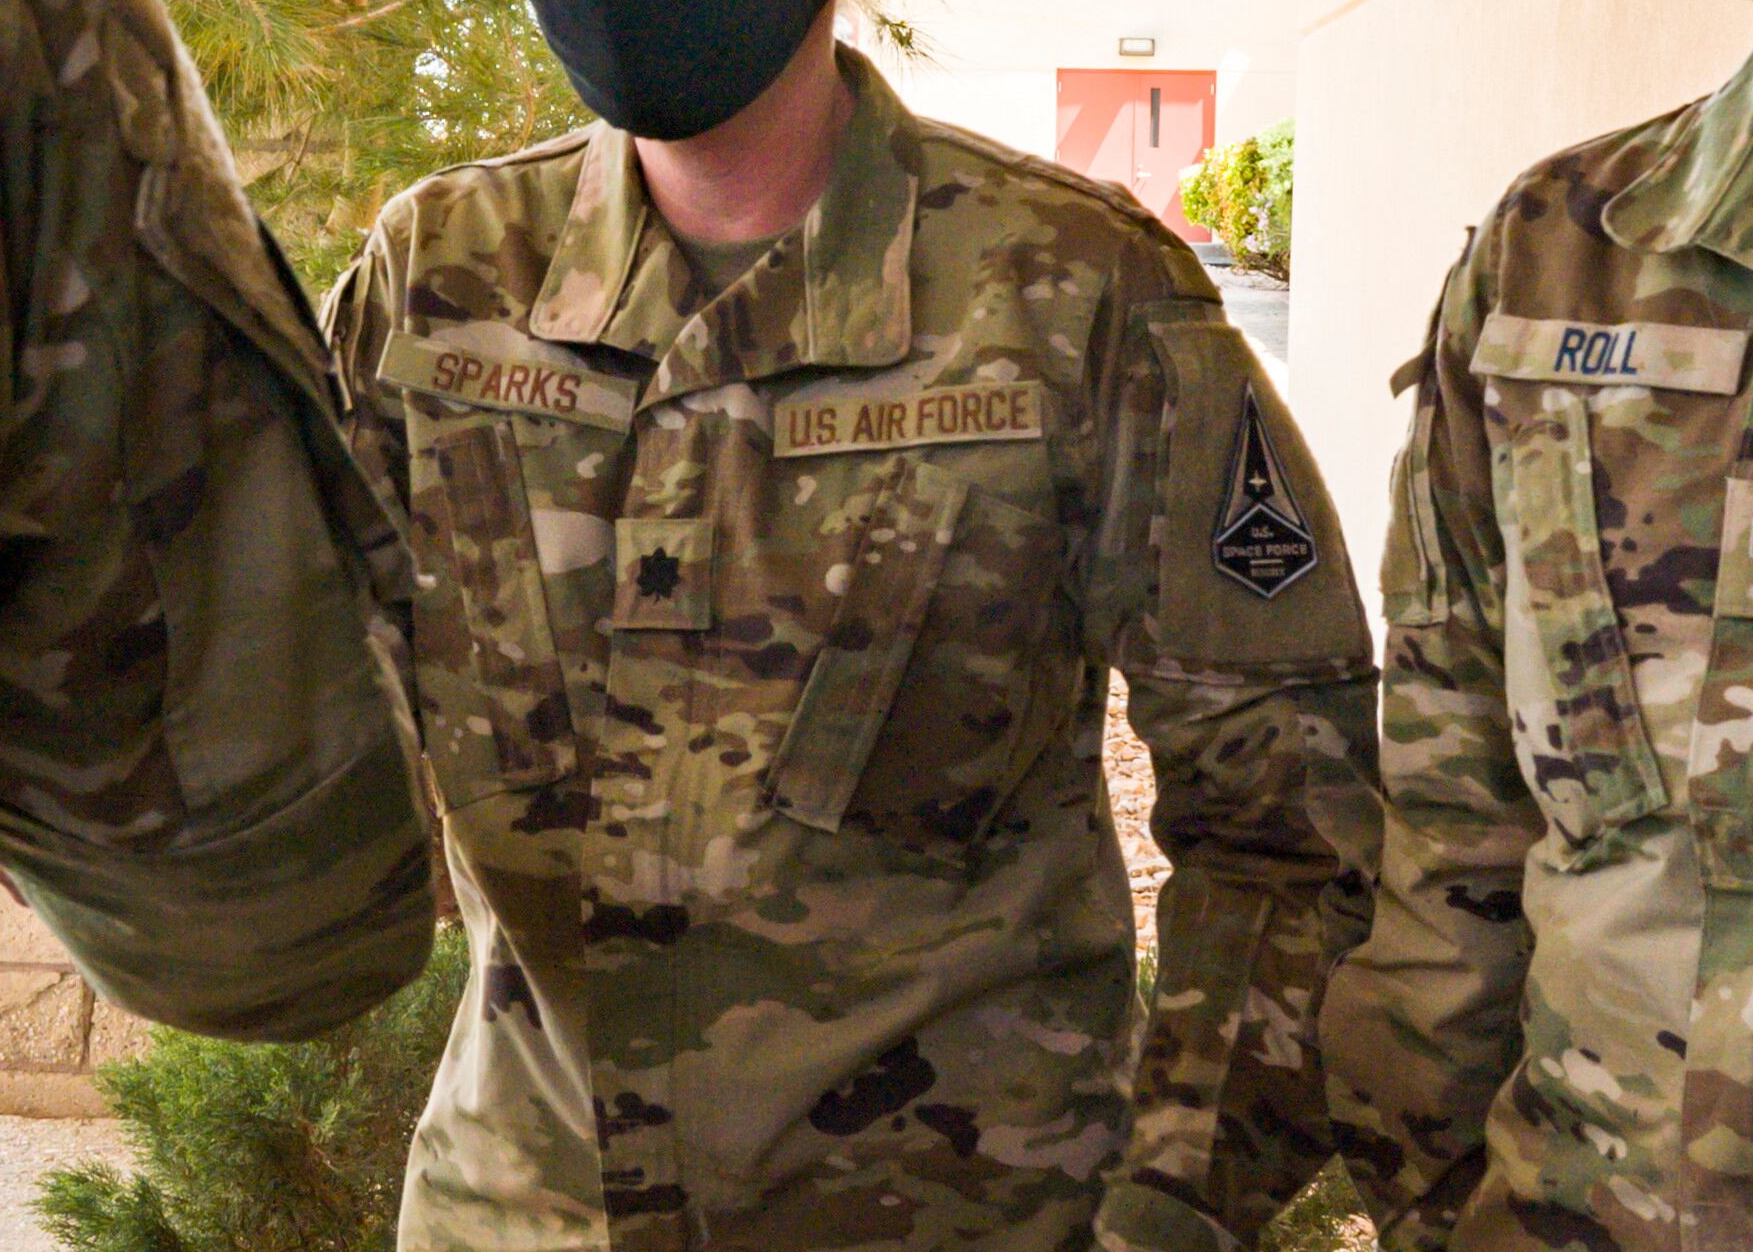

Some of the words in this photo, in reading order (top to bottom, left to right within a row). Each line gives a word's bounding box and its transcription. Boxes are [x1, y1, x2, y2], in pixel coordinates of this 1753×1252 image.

[1553, 327, 1638, 376] ROLL
[432, 352, 581, 413] SPARKS
[852, 401, 907, 443] AIR
[916, 389, 1029, 437] FORCE
[1222, 545, 1263, 558] SPACE
[1265, 543, 1308, 556] FORCE
